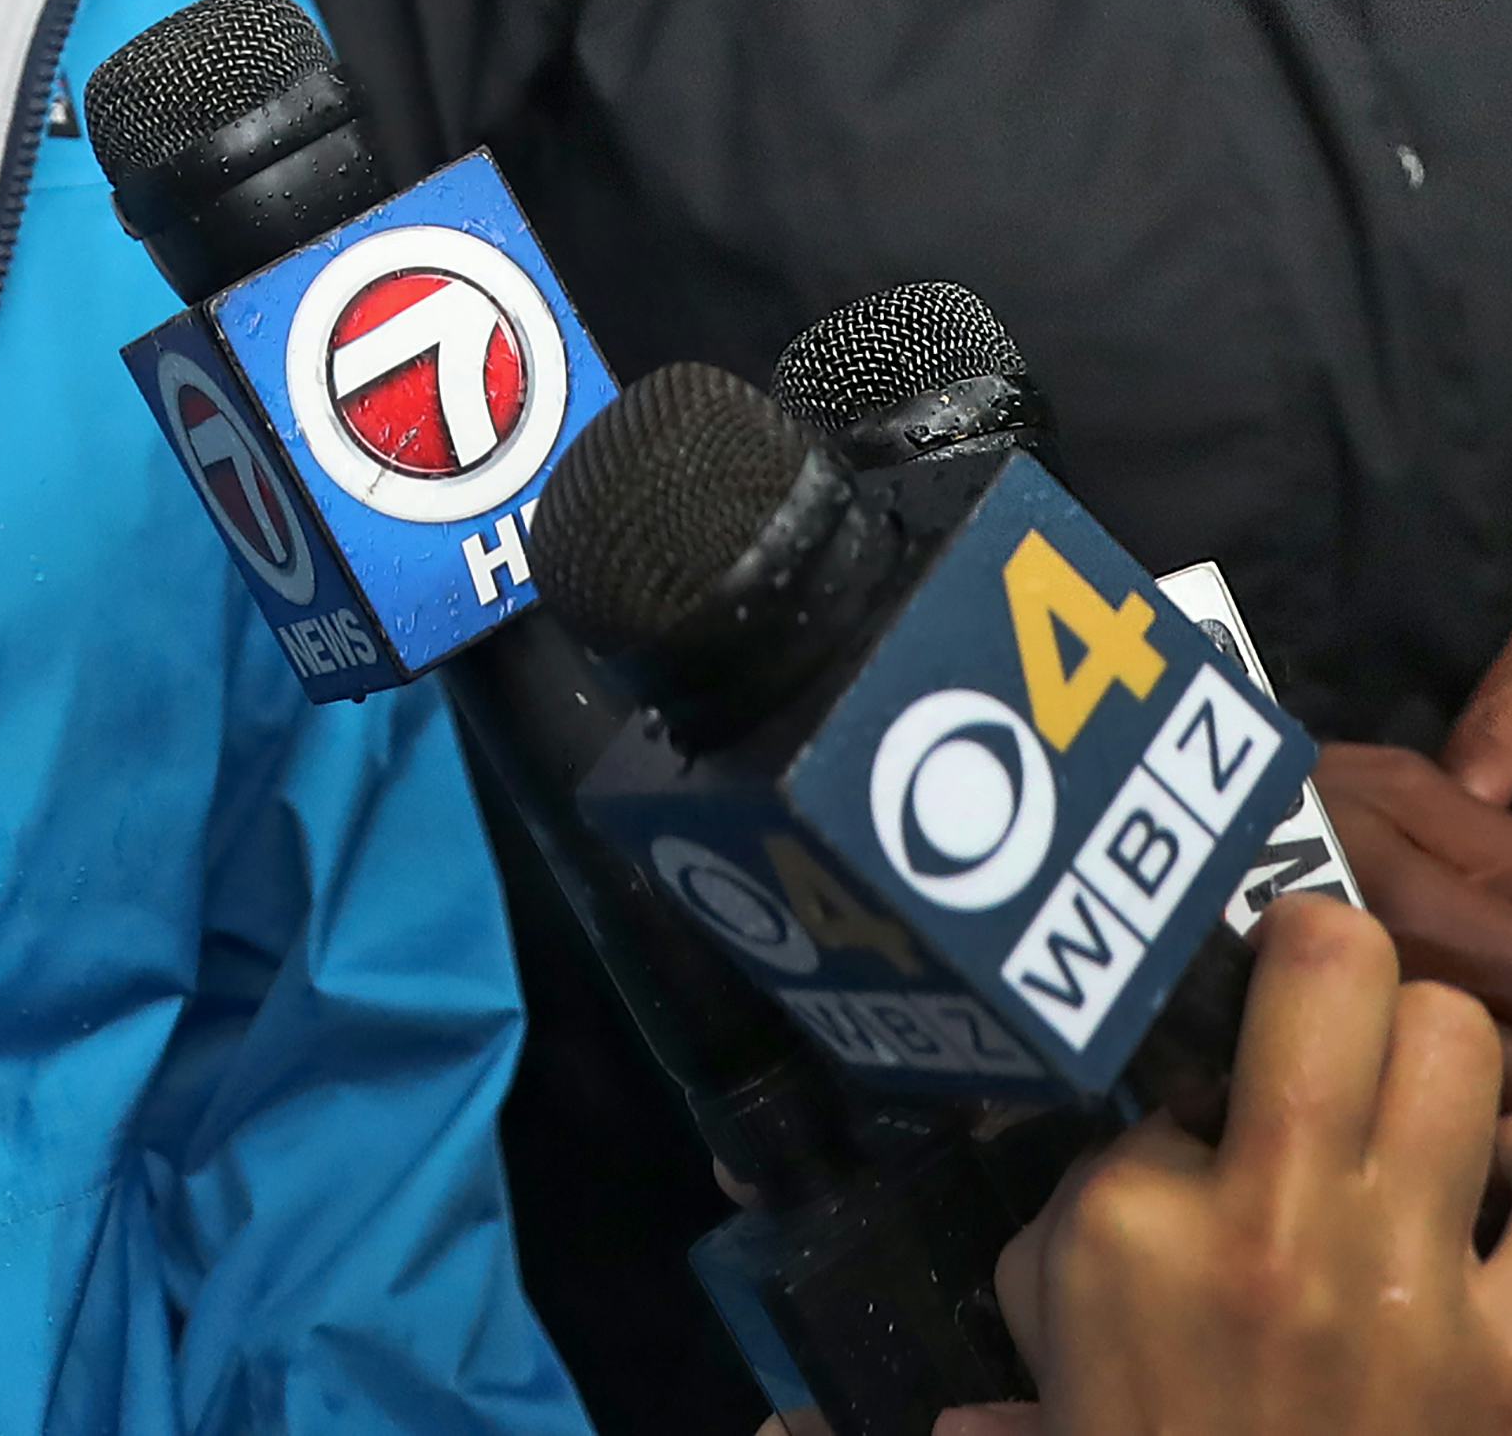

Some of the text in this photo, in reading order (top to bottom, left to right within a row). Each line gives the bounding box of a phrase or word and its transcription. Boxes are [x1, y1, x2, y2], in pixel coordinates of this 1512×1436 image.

[333, 274, 500, 470] 7
[187, 411, 288, 565] 7
[277, 608, 377, 679] NEWS
[1002, 528, 1168, 753] 4
[764, 833, 923, 979] 4
[1020, 696, 1255, 1013] WBZ
[801, 999, 1019, 1065] WBZ
